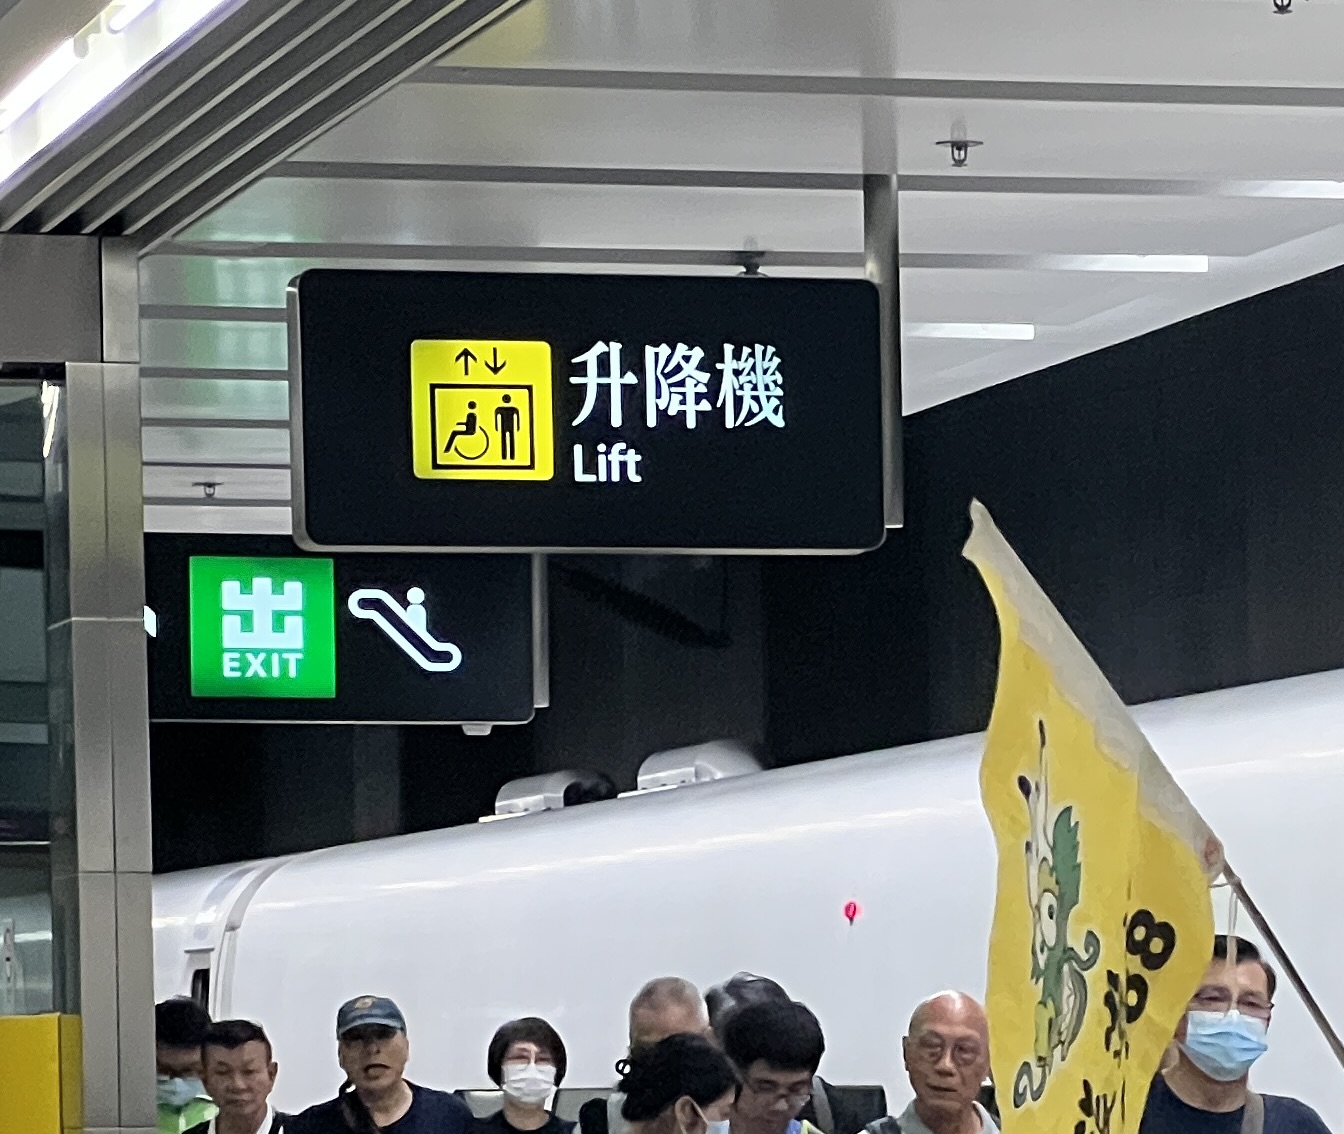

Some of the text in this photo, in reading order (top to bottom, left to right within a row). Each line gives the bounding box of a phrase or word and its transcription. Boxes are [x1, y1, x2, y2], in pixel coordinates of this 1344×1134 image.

[568, 340, 786, 430] 升降機
[573, 443, 643, 483] Lift
[222, 652, 304, 678] EXIT
